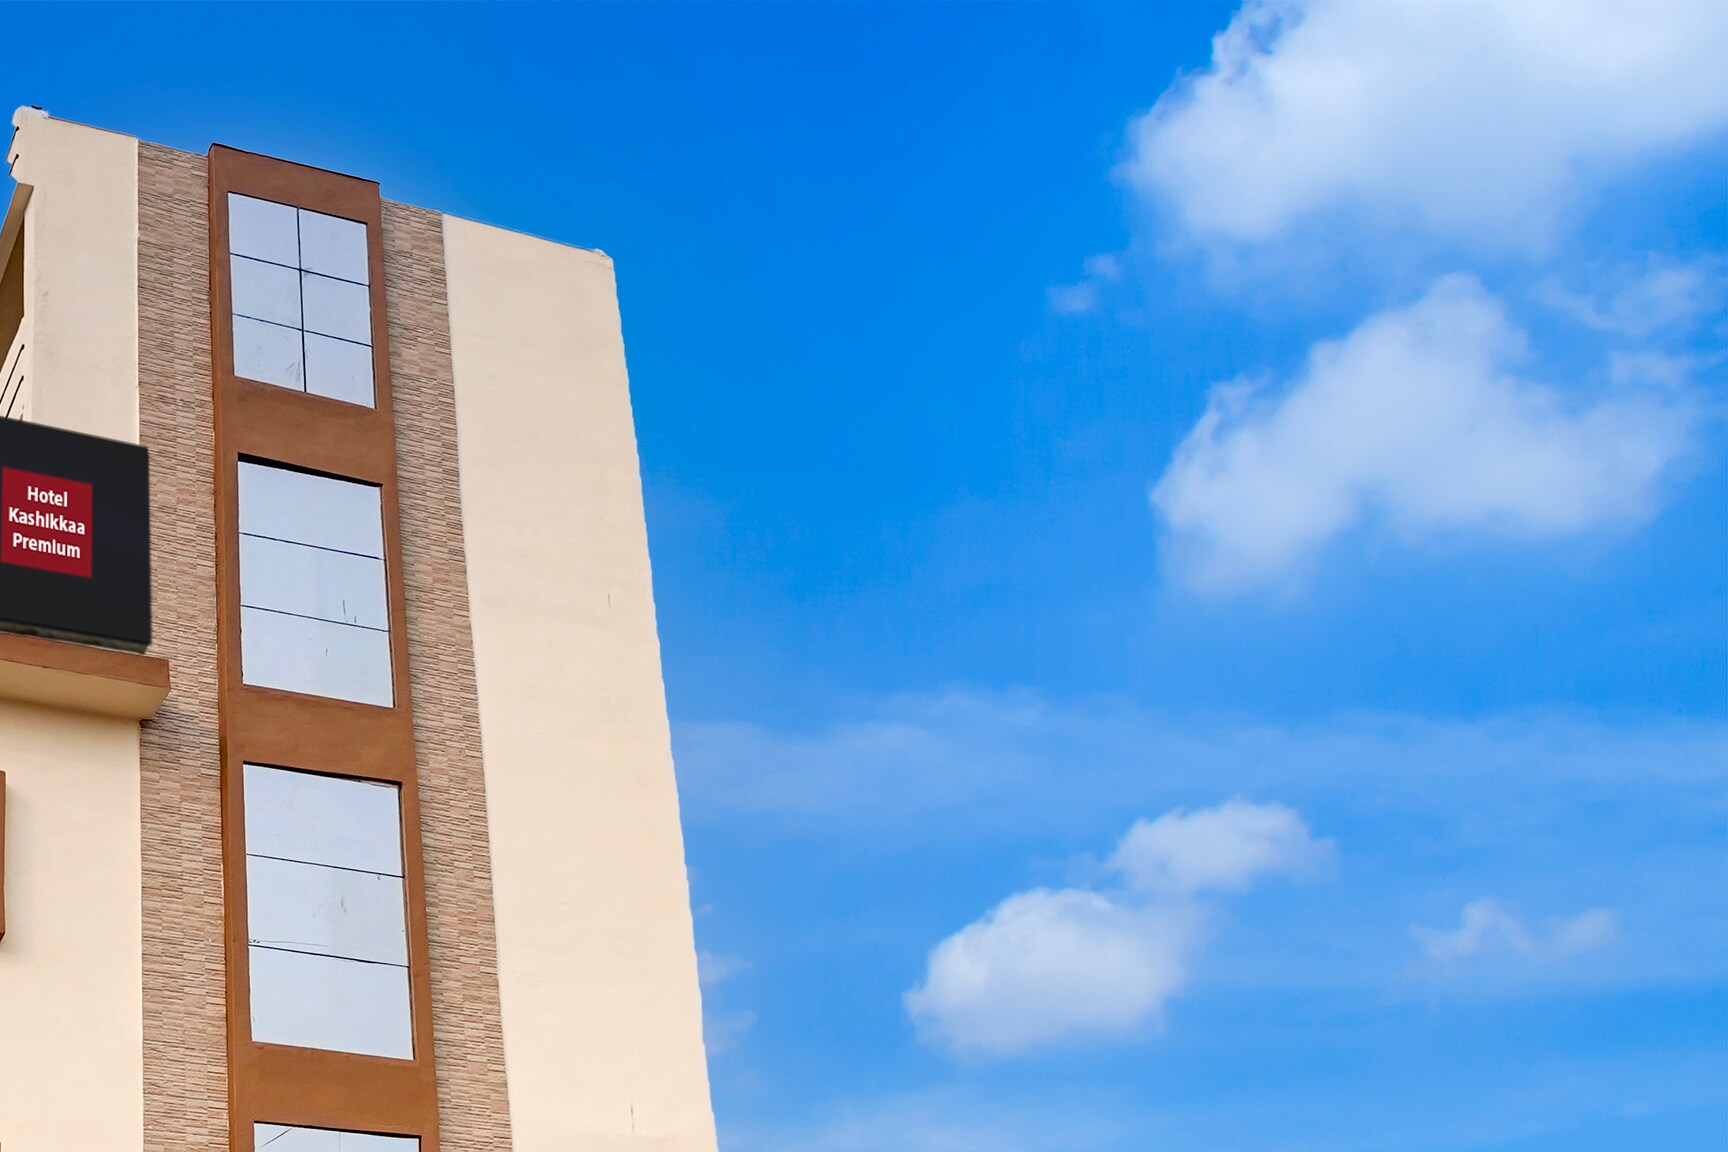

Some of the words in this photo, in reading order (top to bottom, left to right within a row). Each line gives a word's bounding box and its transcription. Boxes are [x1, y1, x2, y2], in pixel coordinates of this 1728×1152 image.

[27, 485, 69, 508] Hotel
[8, 507, 86, 536] Kashikkaa
[12, 532, 82, 559] Premium
